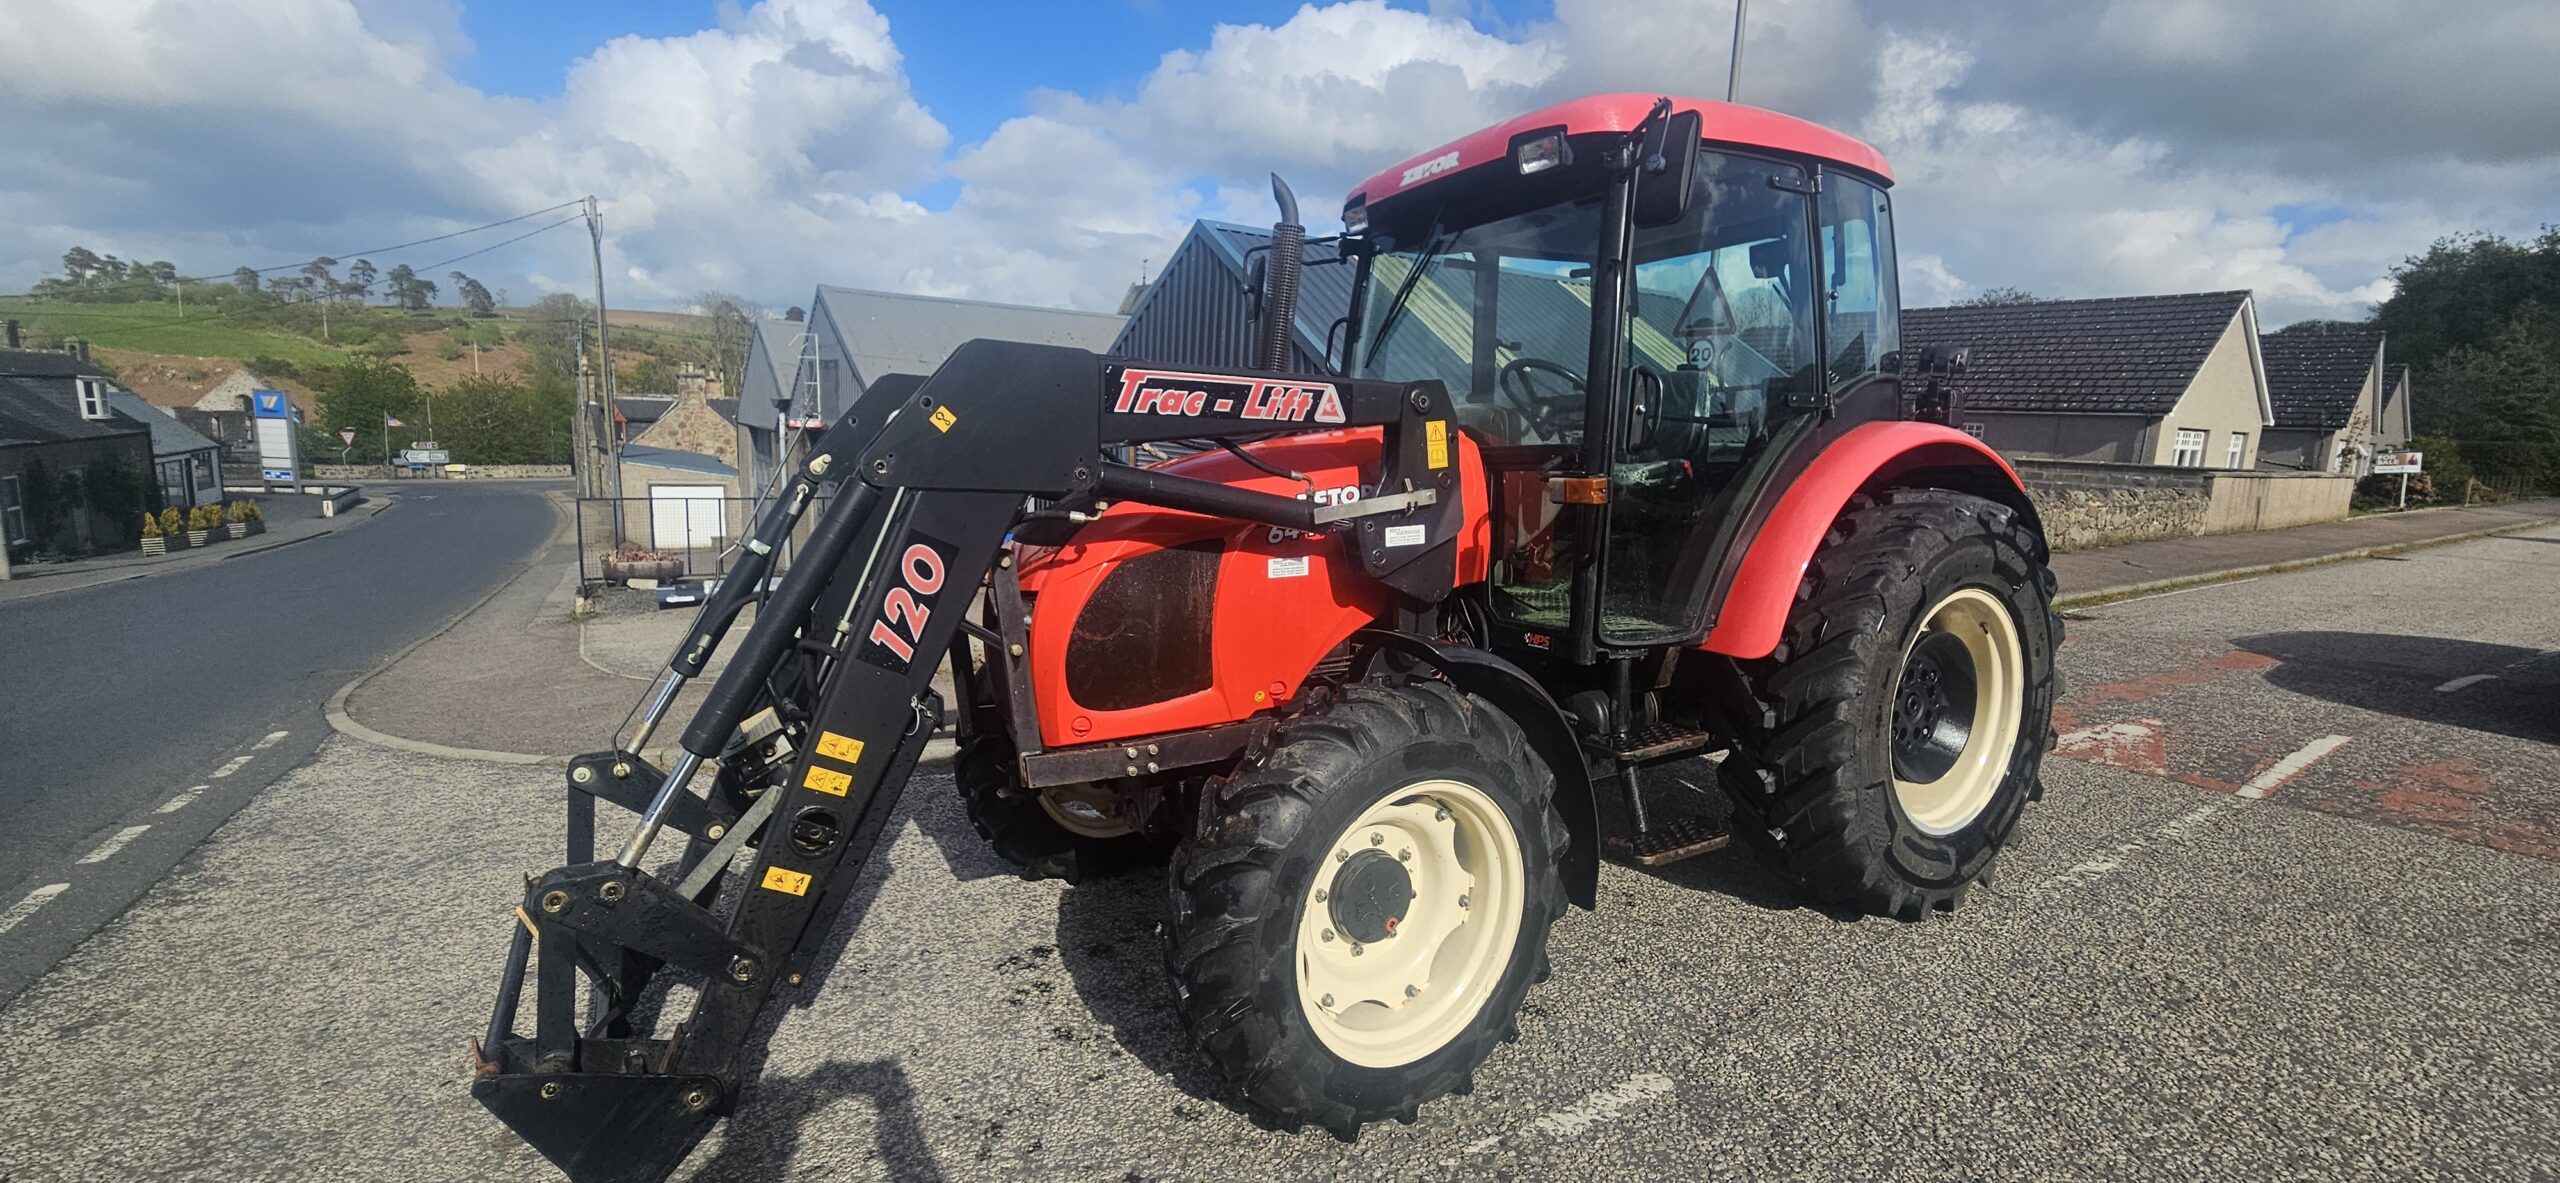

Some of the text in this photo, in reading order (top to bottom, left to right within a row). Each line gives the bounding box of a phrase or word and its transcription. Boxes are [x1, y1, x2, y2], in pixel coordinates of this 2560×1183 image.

[1399, 151, 1459, 187] ZETOR
[1691, 347, 1711, 362] 20
[1114, 369, 1207, 416] Trac
[1240, 381, 1313, 421] Lift
[869, 543, 945, 664] 120
